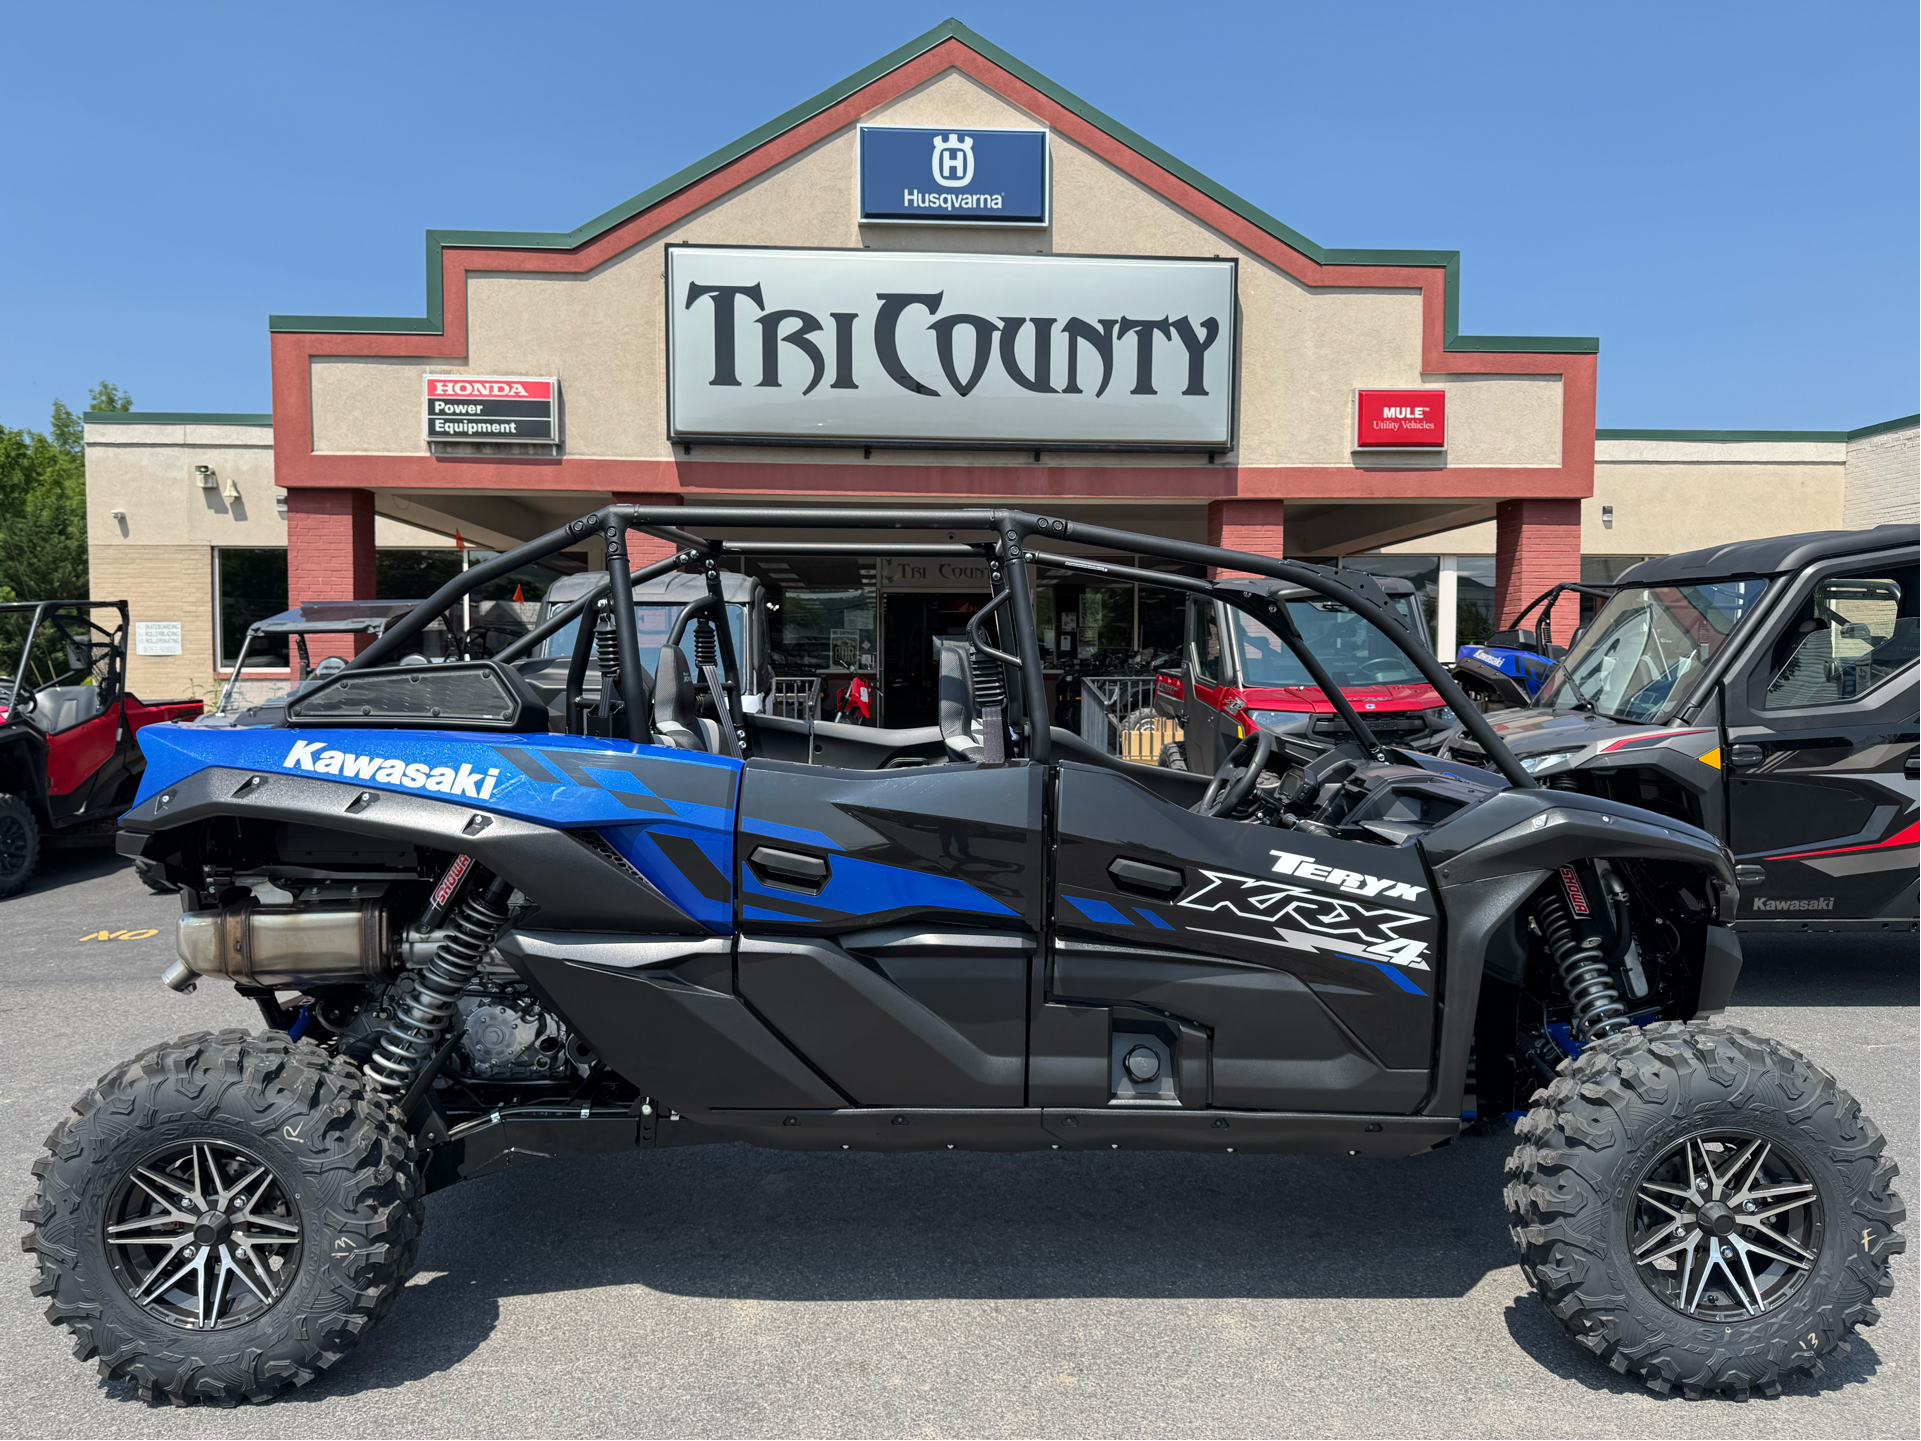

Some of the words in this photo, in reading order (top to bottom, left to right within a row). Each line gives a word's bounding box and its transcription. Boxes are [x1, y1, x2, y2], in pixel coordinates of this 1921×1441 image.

[904, 189, 1003, 211] Husqvarna
[434, 382, 529, 396] HONDA
[434, 401, 483, 414] Power
[434, 419, 517, 434] Equipment
[1373, 420, 1400, 431] Utility
[1401, 420, 1435, 430] Vehicles
[938, 563, 991, 580] COUNT
[1473, 649, 1505, 667] Kawasaki
[282, 740, 500, 800] Kawasaki
[434, 854, 471, 906] SHOWA
[1559, 868, 1589, 914] SHOWA
[1753, 897, 1835, 911] Kawasaki
